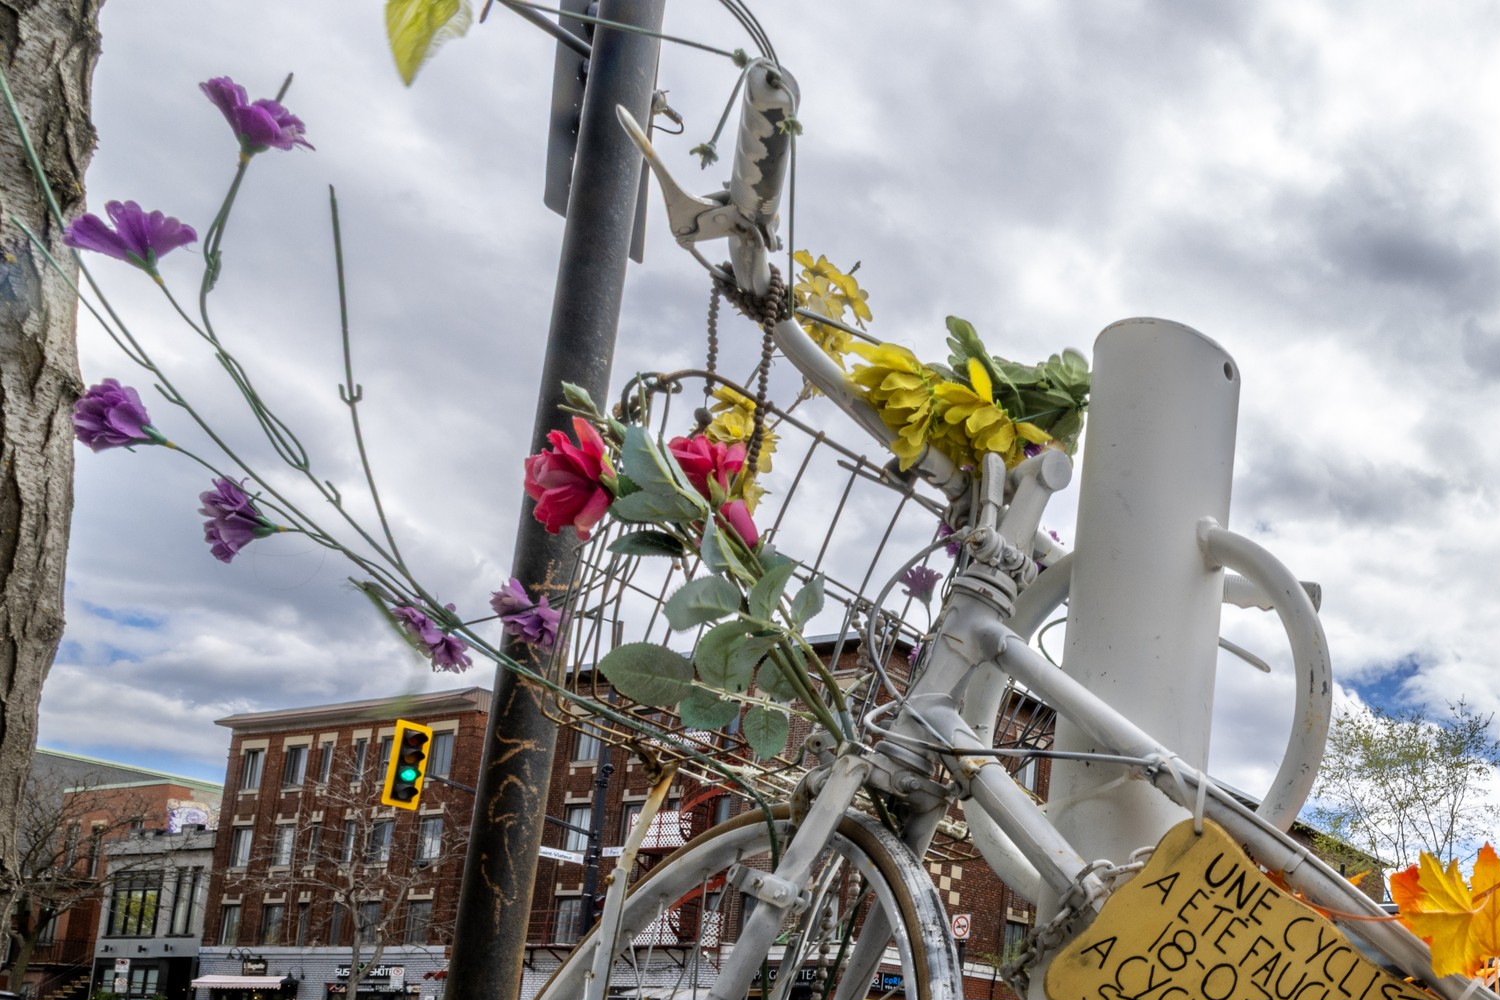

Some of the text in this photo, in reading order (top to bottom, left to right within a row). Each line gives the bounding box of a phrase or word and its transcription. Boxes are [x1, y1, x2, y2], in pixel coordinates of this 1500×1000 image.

[1142, 872, 1180, 905] A
[1204, 852, 1281, 926] UNE
[1080, 936, 1117, 970] A
